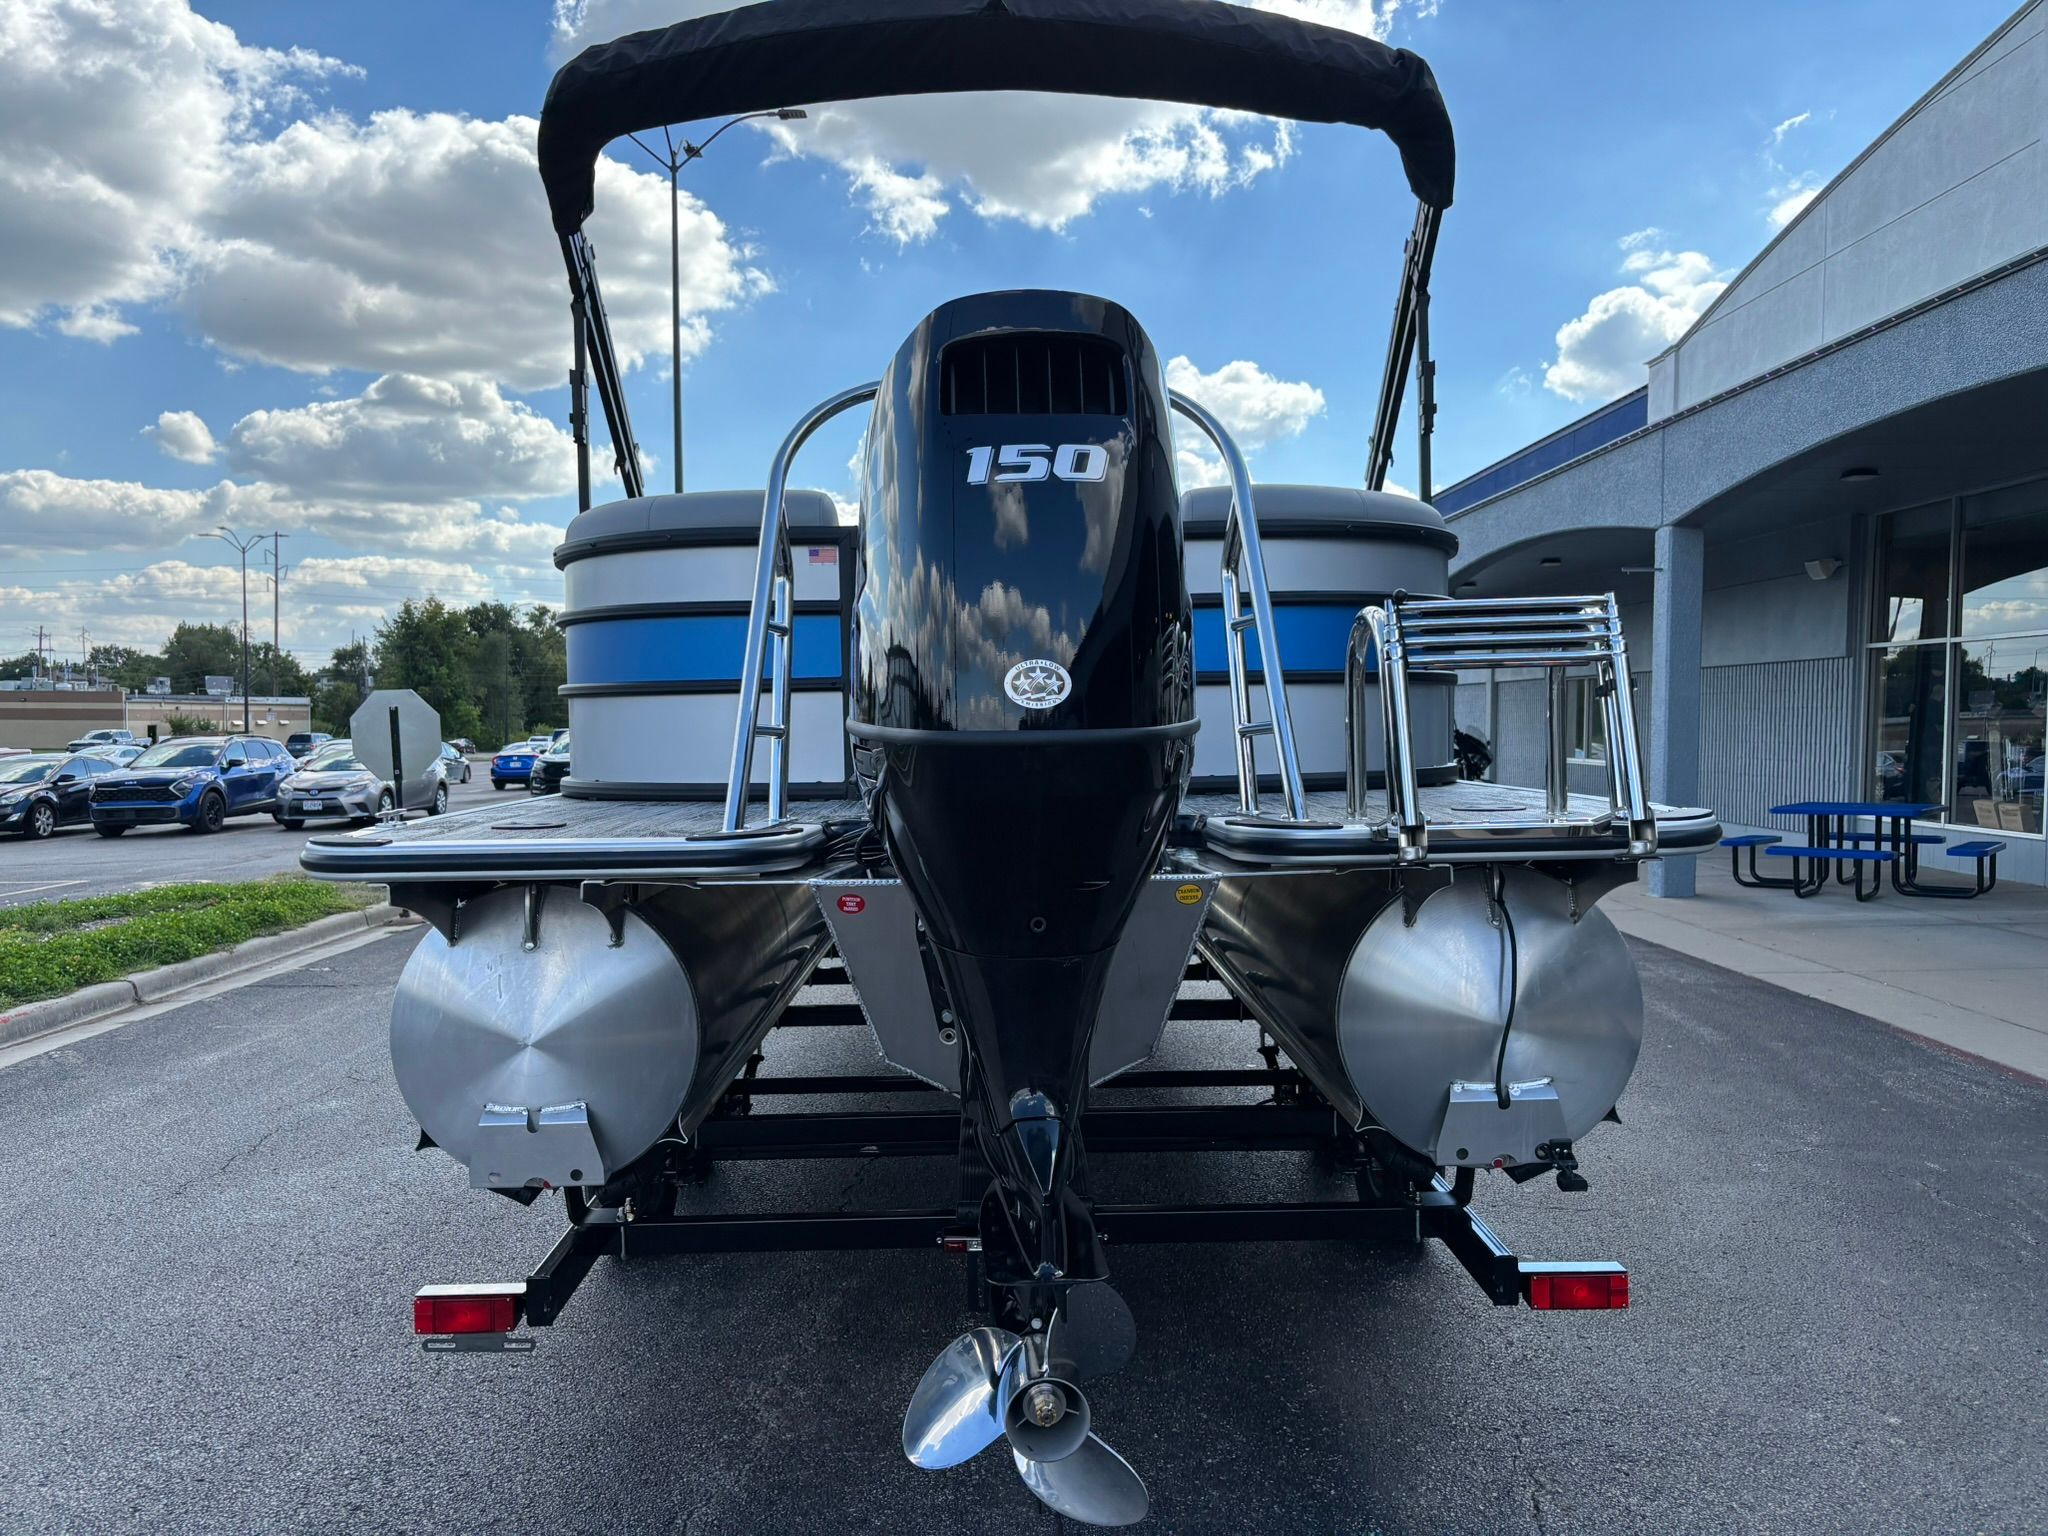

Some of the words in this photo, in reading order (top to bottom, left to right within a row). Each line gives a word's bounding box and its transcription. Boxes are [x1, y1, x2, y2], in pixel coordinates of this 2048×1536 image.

[966, 444, 1110, 485] 150
[1015, 660, 1039, 671] ULTRA
[1044, 660, 1062, 671] LOW
